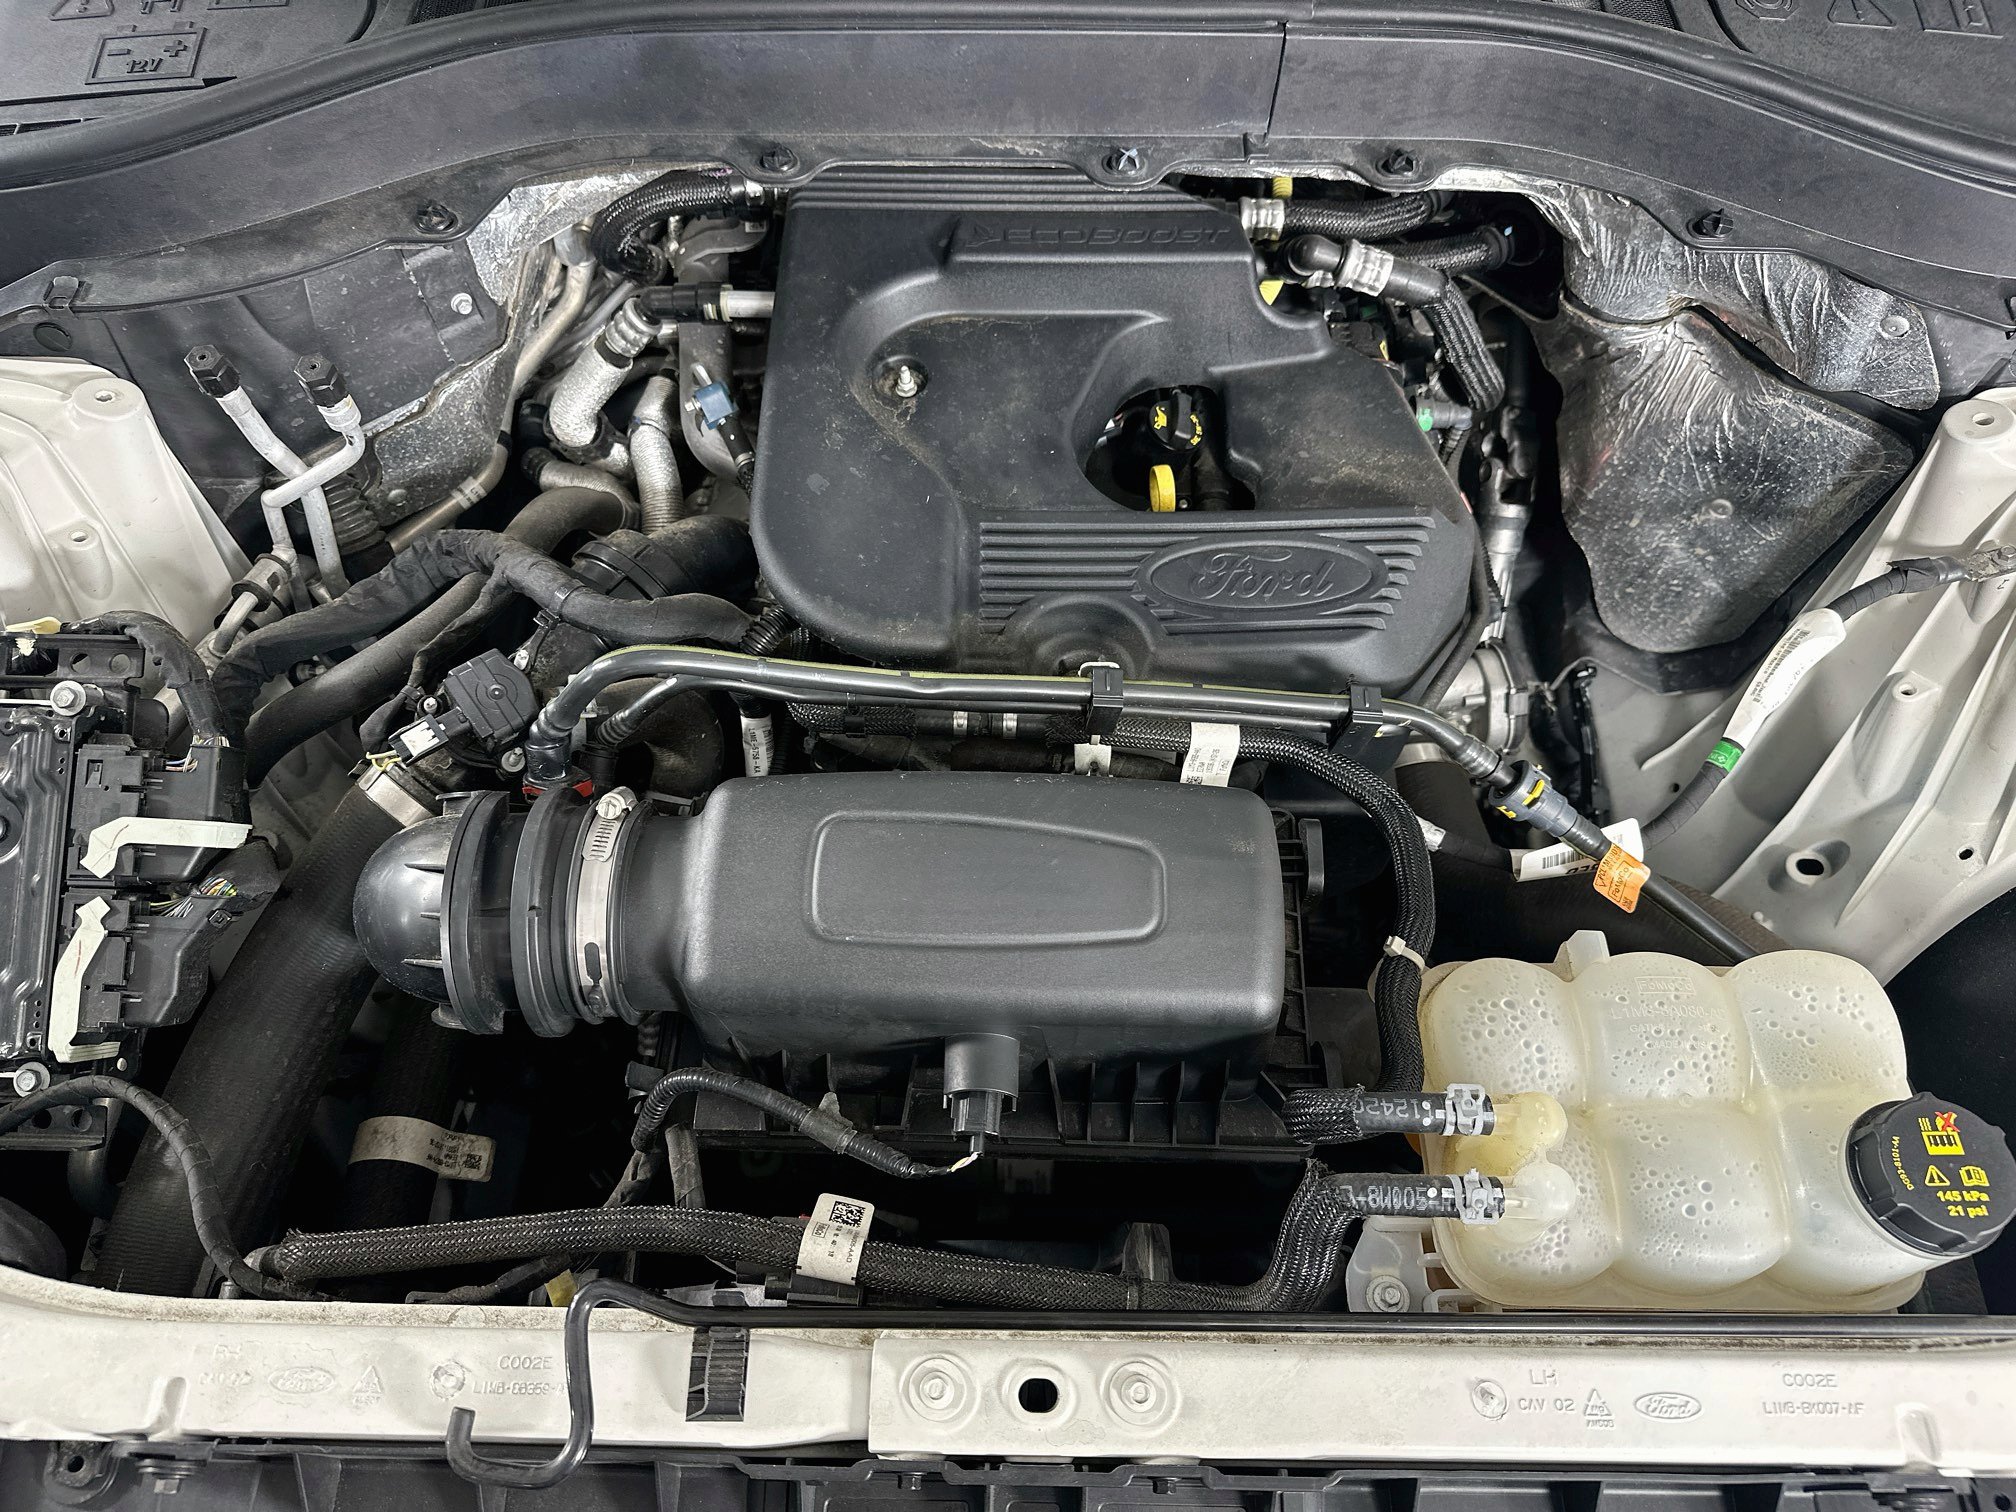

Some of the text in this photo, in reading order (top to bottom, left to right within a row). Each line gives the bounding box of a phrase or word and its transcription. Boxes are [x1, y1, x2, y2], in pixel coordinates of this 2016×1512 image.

[126, 57, 164, 74] 12V
[1189, 549, 1336, 600] Ford
[1936, 1190, 1990, 1202] 145 kPa
[1947, 1205, 1989, 1219] 21 psi
[499, 1355, 553, 1370] C002E
[1529, 1368, 1558, 1385] LH
[1782, 1373, 1838, 1388] C002E
[1518, 1398, 1575, 1412] CAV 02
[1646, 1395, 1693, 1417] Ford
